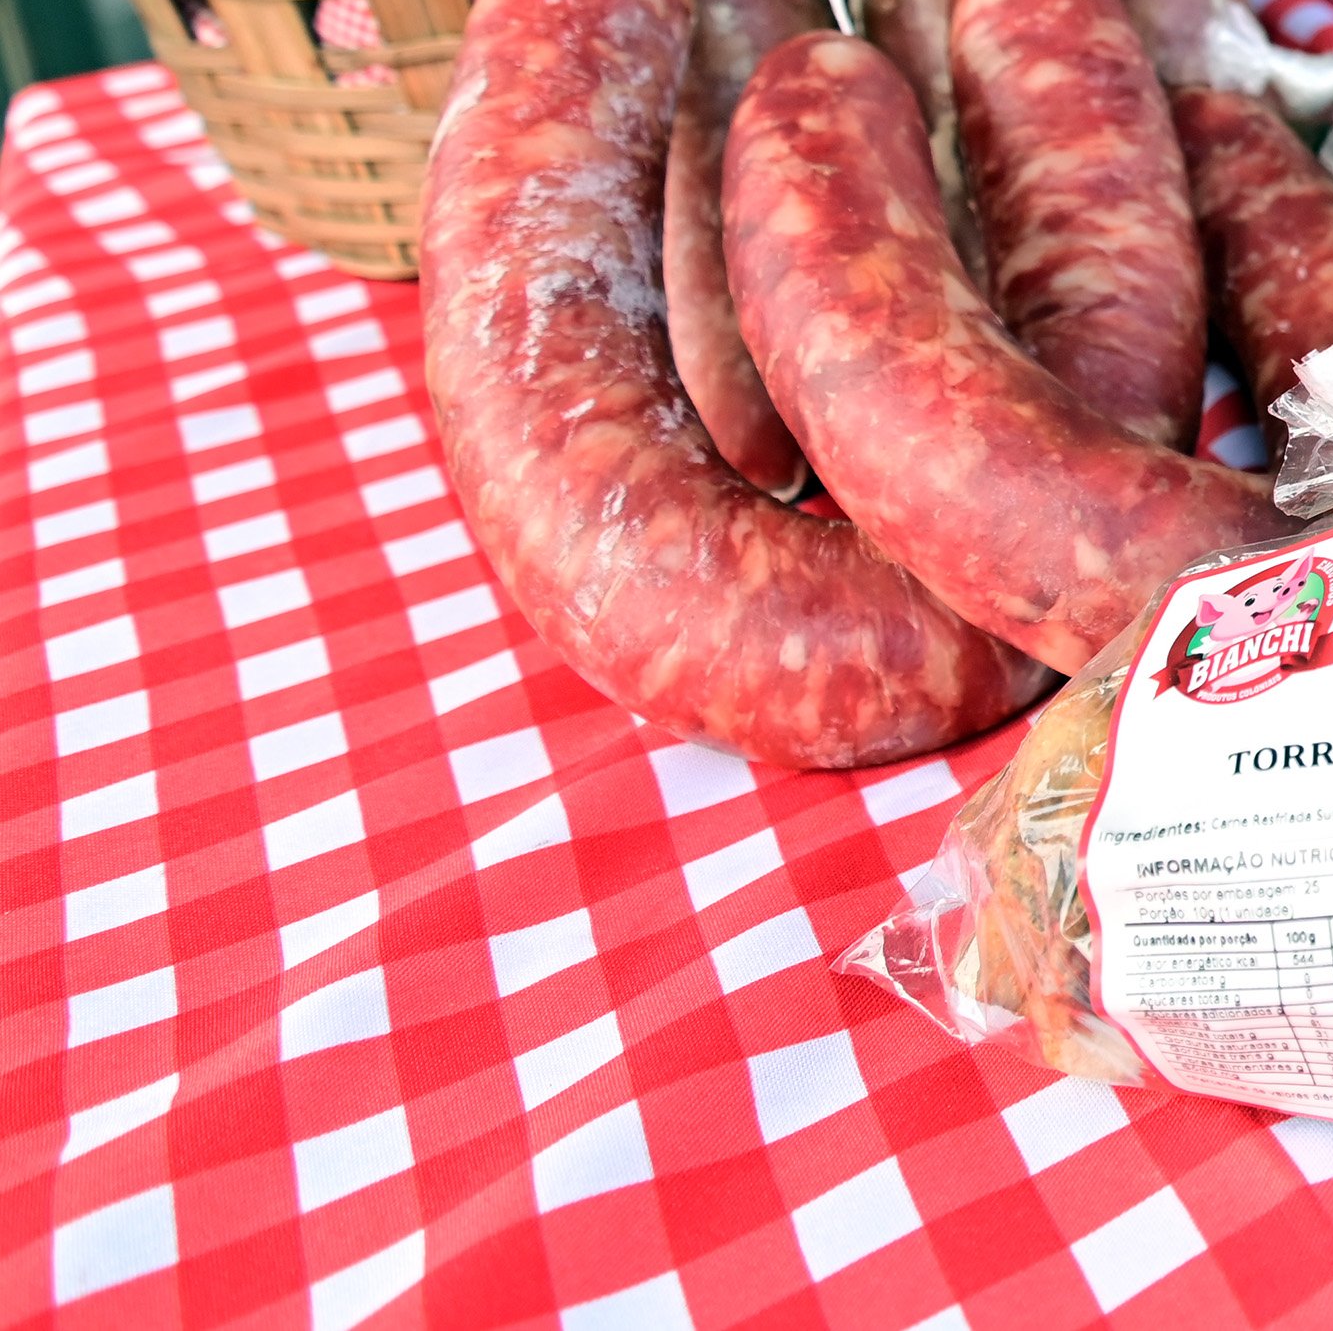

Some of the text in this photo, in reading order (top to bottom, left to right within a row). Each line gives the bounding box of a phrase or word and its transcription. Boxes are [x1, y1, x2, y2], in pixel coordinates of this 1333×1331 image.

[1187, 622, 1315, 693] BIANCHI
[1098, 820, 1206, 846] Ingredientes:
[1137, 851, 1263, 879] INFORMAÇÃO
[1304, 880, 1320, 895] 25
[1133, 933, 1196, 947] Quantidade
[1200, 935, 1217, 947] por
[1221, 932, 1258, 947] porção
[1286, 931, 1316, 944] 100g
[1293, 954, 1314, 965] 544
[1202, 1008, 1272, 1020] adicionados
